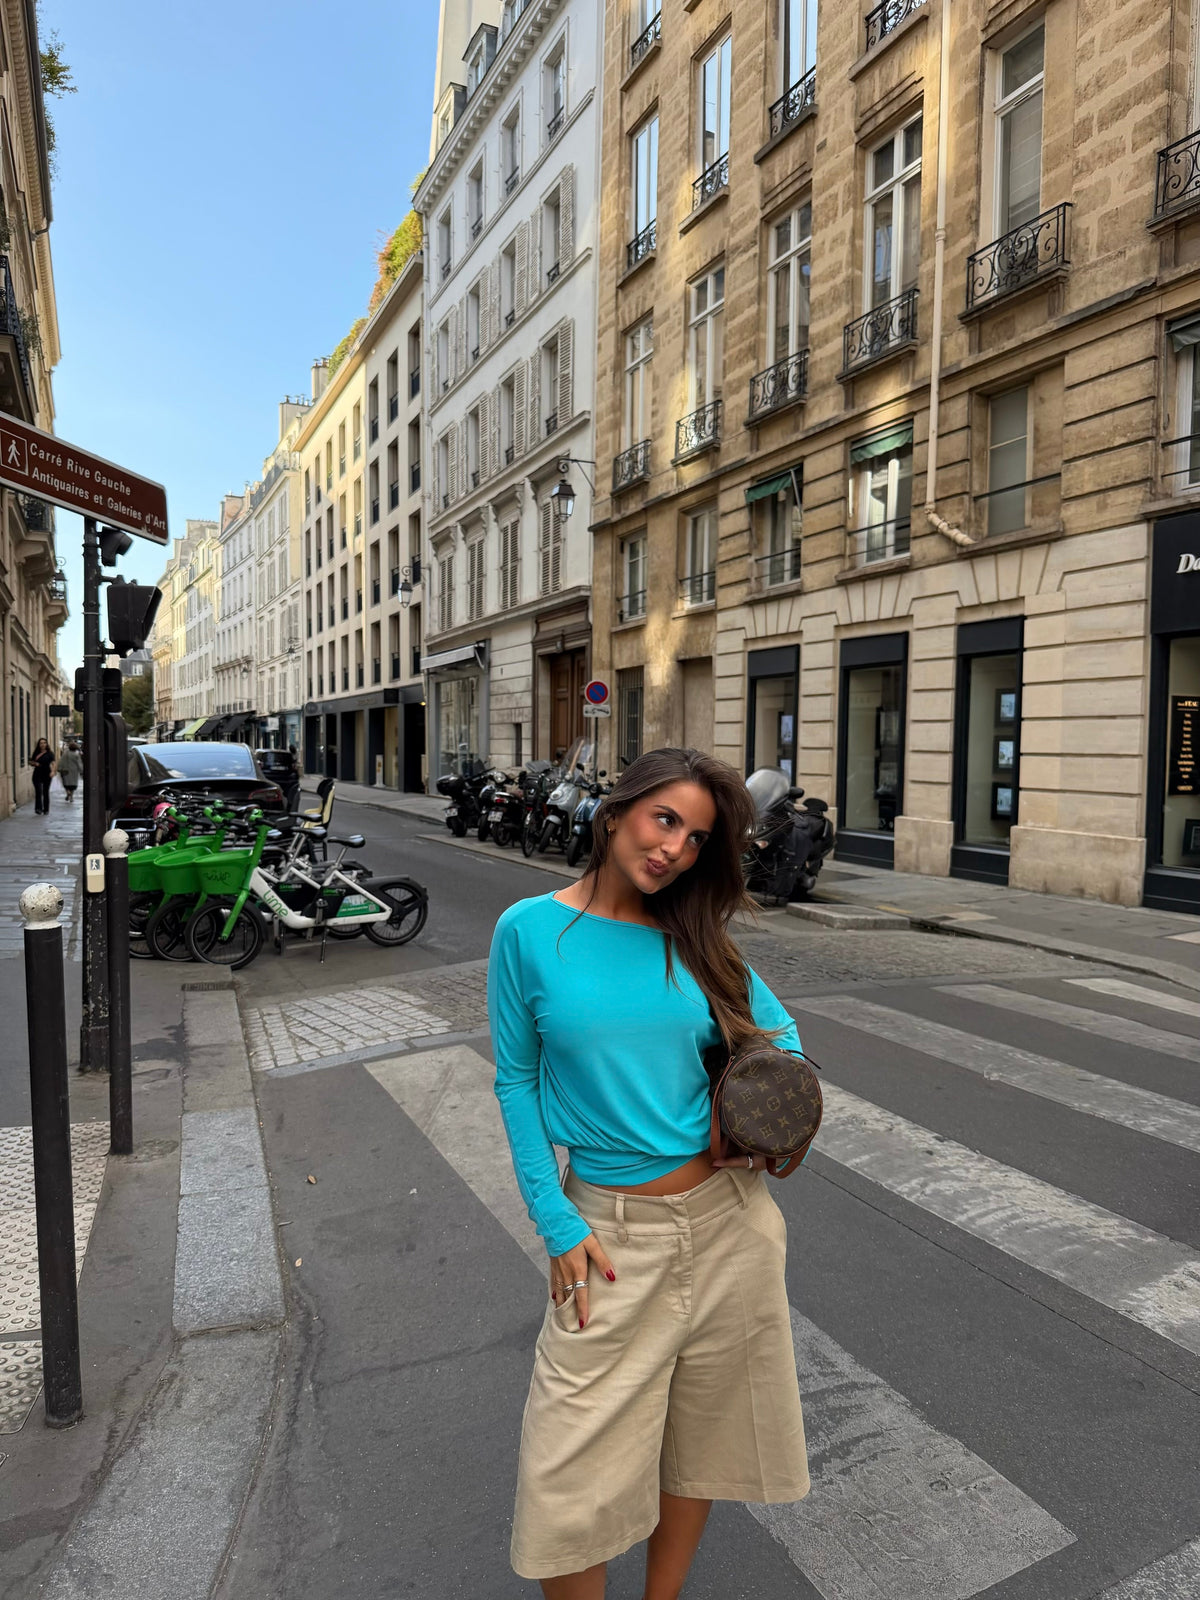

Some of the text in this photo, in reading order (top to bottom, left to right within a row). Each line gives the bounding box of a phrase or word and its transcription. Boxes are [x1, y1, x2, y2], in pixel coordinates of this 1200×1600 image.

[30, 443, 131, 496] Carré Rive Gauche
[32, 467, 166, 531] Antiquaires et Galeries d'Art
[263, 889, 289, 917] Lime
